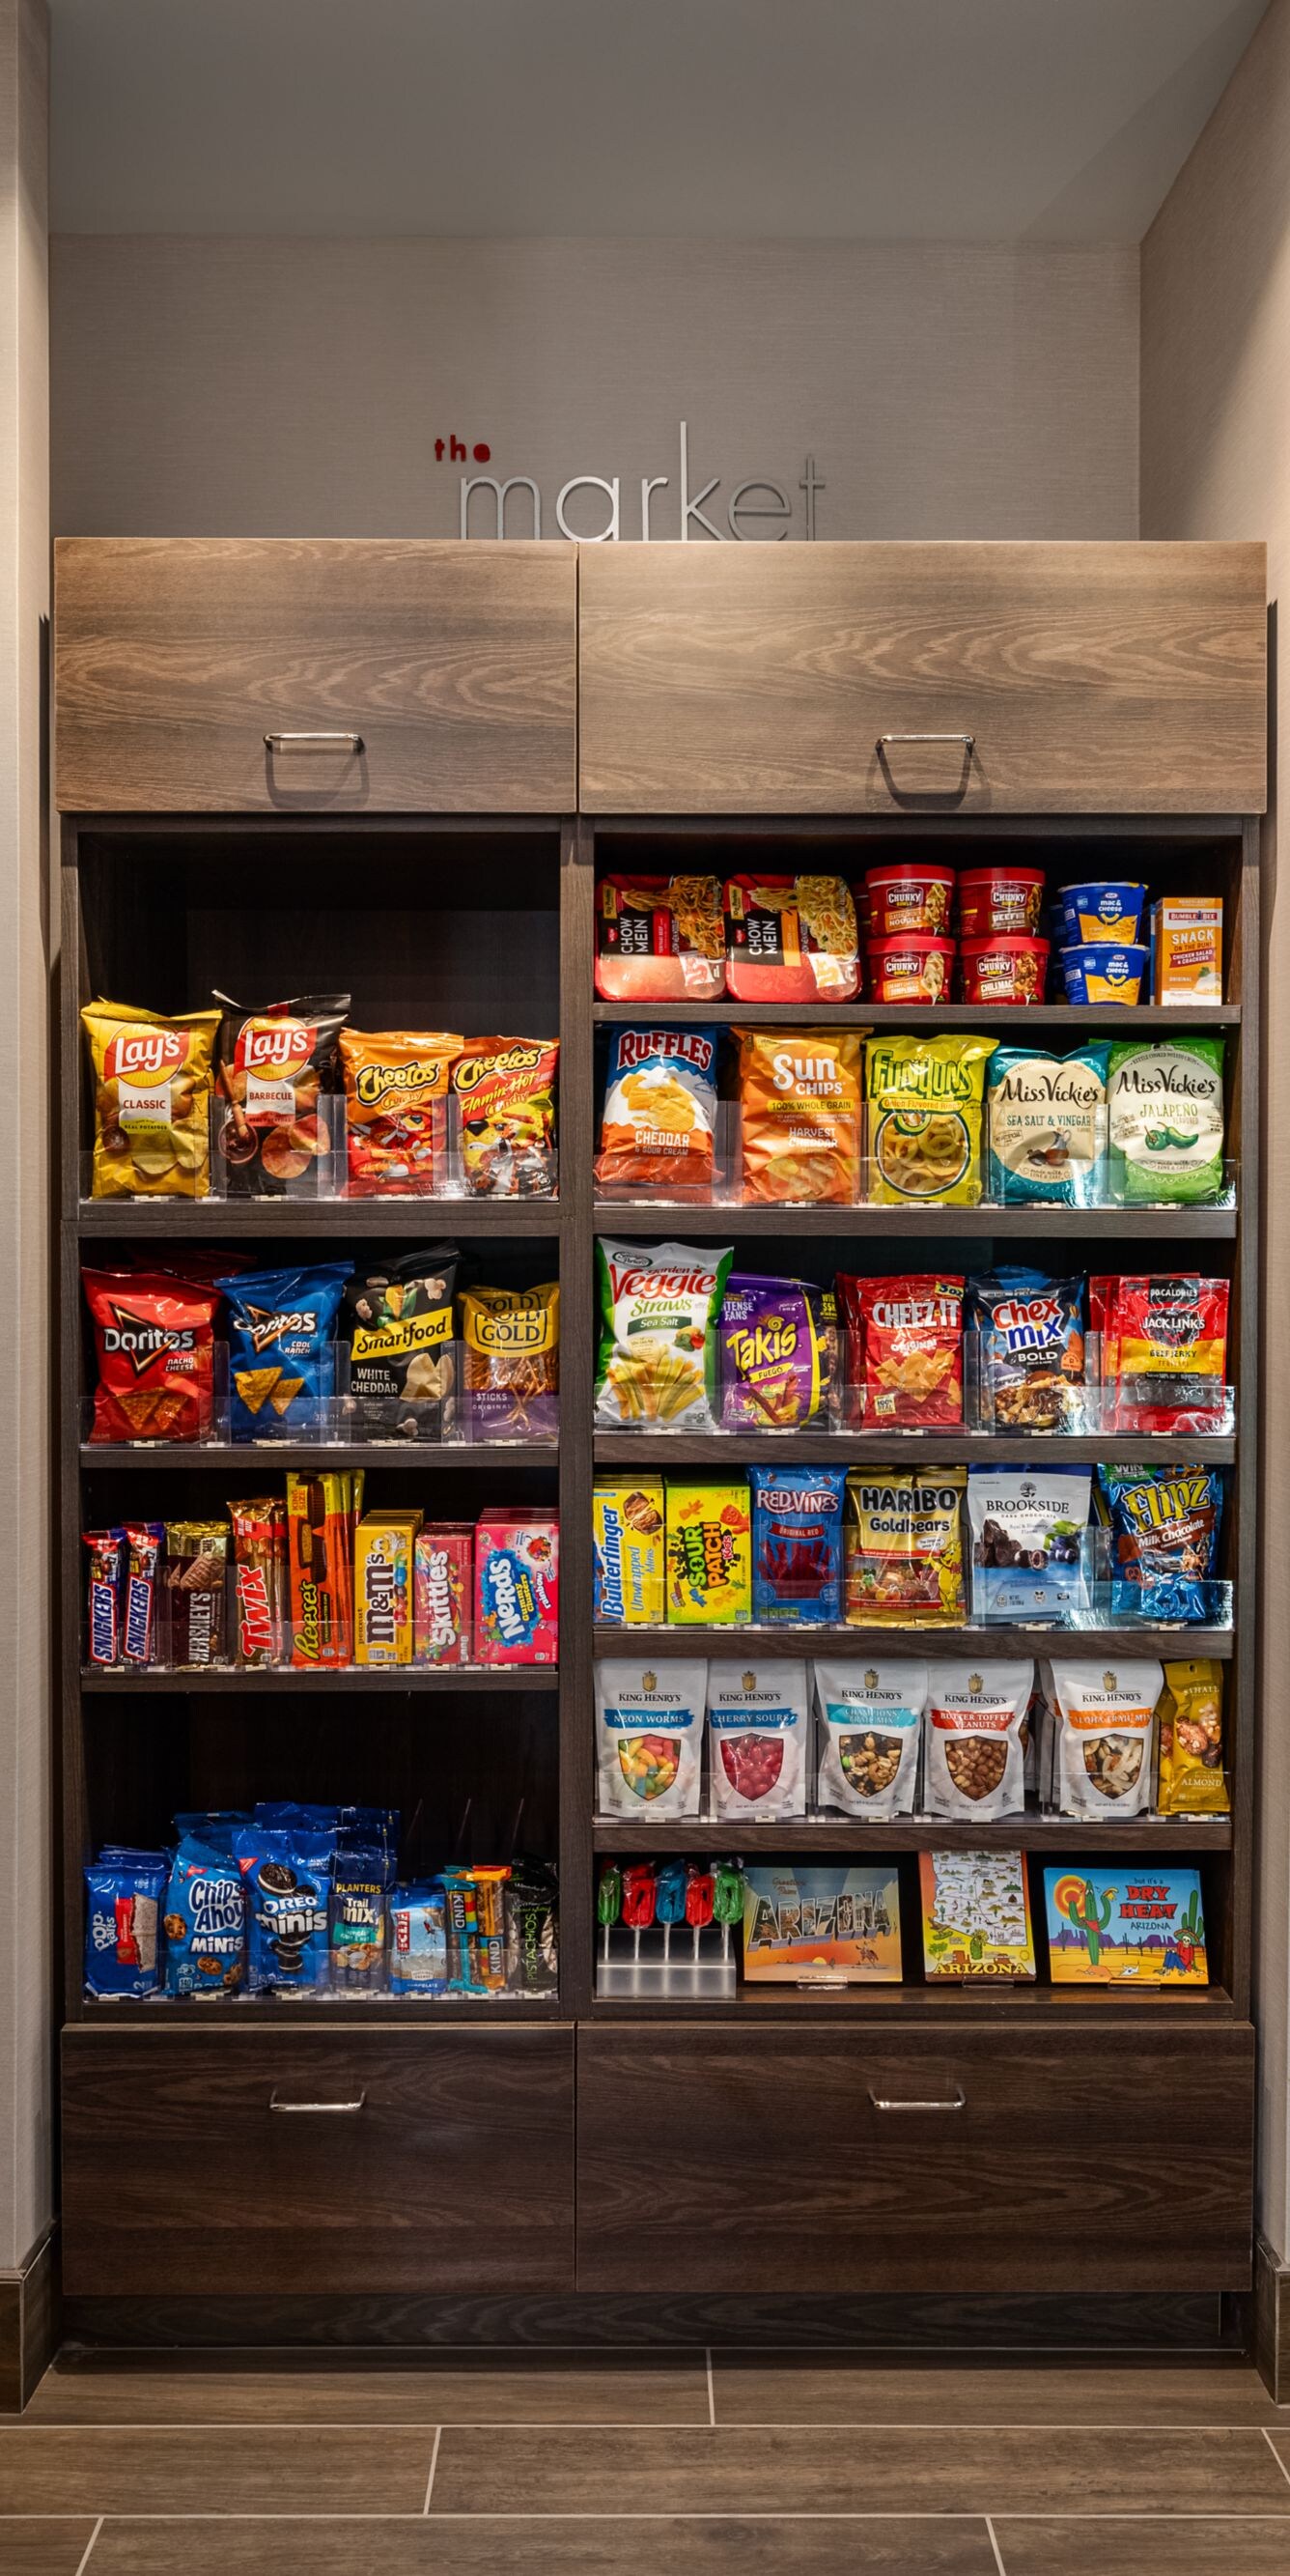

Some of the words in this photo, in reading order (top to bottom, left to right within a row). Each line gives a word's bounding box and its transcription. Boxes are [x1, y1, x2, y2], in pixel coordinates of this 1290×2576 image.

[435, 435, 491, 463] the
[461, 421, 826, 542] market
[889, 893, 921, 904] CHUNKY
[993, 892, 1025, 903] CHUNKY
[889, 917, 921, 926] NOODLE
[621, 918, 633, 954] CHOW
[635, 920, 648, 952] MEIN
[748, 919, 761, 954] CHOW
[765, 920, 776, 954] MEIN
[1172, 929, 1214, 945] SNACK
[885, 961, 918, 973] CHUNKY
[979, 961, 1012, 973] CHUNKY
[997, 979, 1014, 989] MAC
[115, 1033, 181, 1074] Lay's
[244, 1030, 308, 1067] Lay's
[617, 1031, 713, 1071] RUFFLES
[456, 1046, 540, 1090] Cheetos
[773, 1054, 835, 1090] Sun
[357, 1062, 437, 1102] Cheetos
[461, 1085, 507, 1113] Flamin'
[509, 1072, 539, 1090] Hot
[796, 1083, 843, 1094] CHIPS
[1000, 1078, 1045, 1102] Miss
[1042, 1072, 1099, 1109] Vickie's
[1116, 1072, 1161, 1094] Miss
[1155, 1065, 1216, 1099] Vickie's
[124, 1100, 166, 1109] CLASSIC
[908, 1100, 939, 1109] Flavored
[790, 1127, 835, 1137] HARVEST
[1007, 1116, 1023, 1125] SEA
[1025, 1116, 1043, 1125] SALT
[1048, 1117, 1054, 1125] &
[1058, 1116, 1090, 1126] VINEGAR
[635, 1131, 689, 1146] CHEDDAR
[789, 1139, 838, 1147] CHEDDAR
[609, 1264, 716, 1304] Veggie
[939, 1285, 948, 1293] 3
[631, 1298, 692, 1317] Straws
[725, 1311, 747, 1321] FANS
[993, 1299, 1062, 1328] Chex
[234, 1312, 316, 1335] Doritos
[482, 1325, 540, 1341] GOLD
[640, 1317, 657, 1328] Sea
[659, 1316, 679, 1326] Salt
[1008, 1316, 1063, 1350] mix
[1143, 1319, 1171, 1328] JACK
[104, 1329, 193, 1350] Doritos
[357, 1320, 447, 1352] Smartfood
[1019, 1352, 1057, 1362] BOLD
[357, 1368, 390, 1379] WHITE
[758, 1367, 782, 1379] FUEGO
[351, 1381, 398, 1393] CHEDDAR
[757, 1490, 796, 1514] RED
[788, 1490, 838, 1514] VINES
[861, 1488, 956, 1512] HARIBO
[986, 1500, 1069, 1514] BROOKSIDE
[1125, 1478, 1208, 1534] Flipz
[779, 1528, 805, 1537] ORIGINAL
[870, 1518, 950, 1533] Goldbears
[1139, 1537, 1160, 1547] Milk
[1163, 1519, 1204, 1542] Chocolate
[686, 1527, 706, 1586] SOUR
[703, 1522, 726, 1589] PATCH
[723, 1535, 733, 1560] Kids
[602, 1506, 625, 1616] Butterfinger
[646, 1548, 655, 1573] Minis
[536, 1571, 551, 1609] rainbow
[628, 1545, 645, 1611] Unwrapped
[366, 1554, 394, 1643] m&m's
[428, 1551, 456, 1645] Skittles
[516, 1583, 529, 1621] Gummy
[520, 1573, 534, 1612] Clusters
[94, 1584, 112, 1660] SNICKERS
[126, 1579, 150, 1656] SNICKERS
[189, 1593, 211, 1662] HERSHEY'S
[294, 1580, 320, 1660] Reese's
[866, 1691, 902, 1700] HENRY'S
[189, 1880, 244, 1912] Chips
[337, 1883, 381, 1893] PLANTERS
[1127, 1885, 1171, 1902] DRY
[264, 1896, 317, 1913] OREO
[346, 1898, 369, 1909] Trail
[453, 1895, 464, 1928] KIND
[1119, 1903, 1178, 1920] HEAT
[195, 1901, 244, 1932] Ahoy
[256, 1910, 327, 1934] minis
[343, 1909, 376, 1924] mix
[747, 1889, 890, 1952] ARIZONA
[1131, 1921, 1171, 1930] ARIZONA
[104, 1917, 119, 1947] tarts
[491, 1940, 501, 1974] KIND
[525, 1913, 537, 1980] PISTACHIOS
[933, 1963, 1028, 1975] ARIZONA
